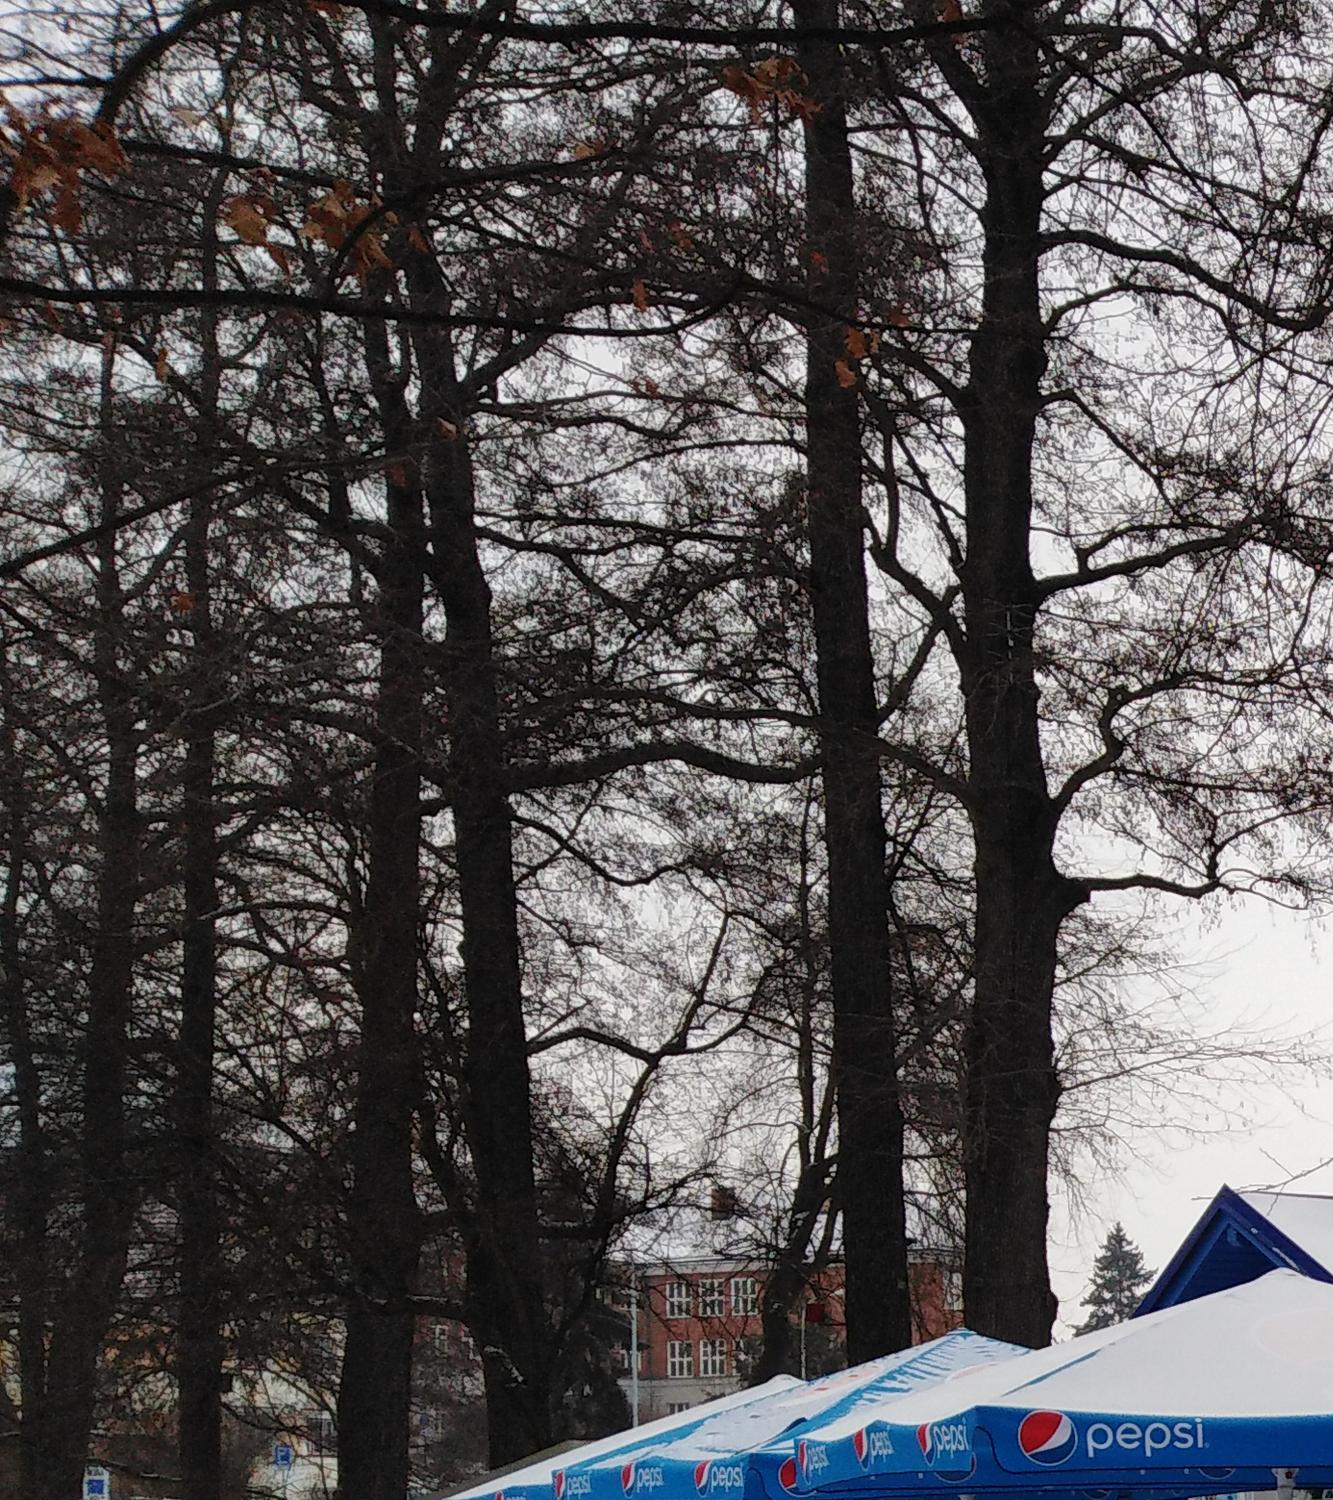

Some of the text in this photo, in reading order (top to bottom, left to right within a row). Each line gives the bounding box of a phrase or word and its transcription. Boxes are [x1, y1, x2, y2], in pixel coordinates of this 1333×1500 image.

[869, 1425, 895, 1465] pepsi
[933, 1417, 969, 1460] pepsi
[1087, 1417, 1203, 1458] pepsi
[808, 1445, 831, 1476] pepsi
[566, 1470, 592, 1500] pepsi
[635, 1466, 664, 1493] pepsi
[711, 1464, 744, 1493] pepsi
